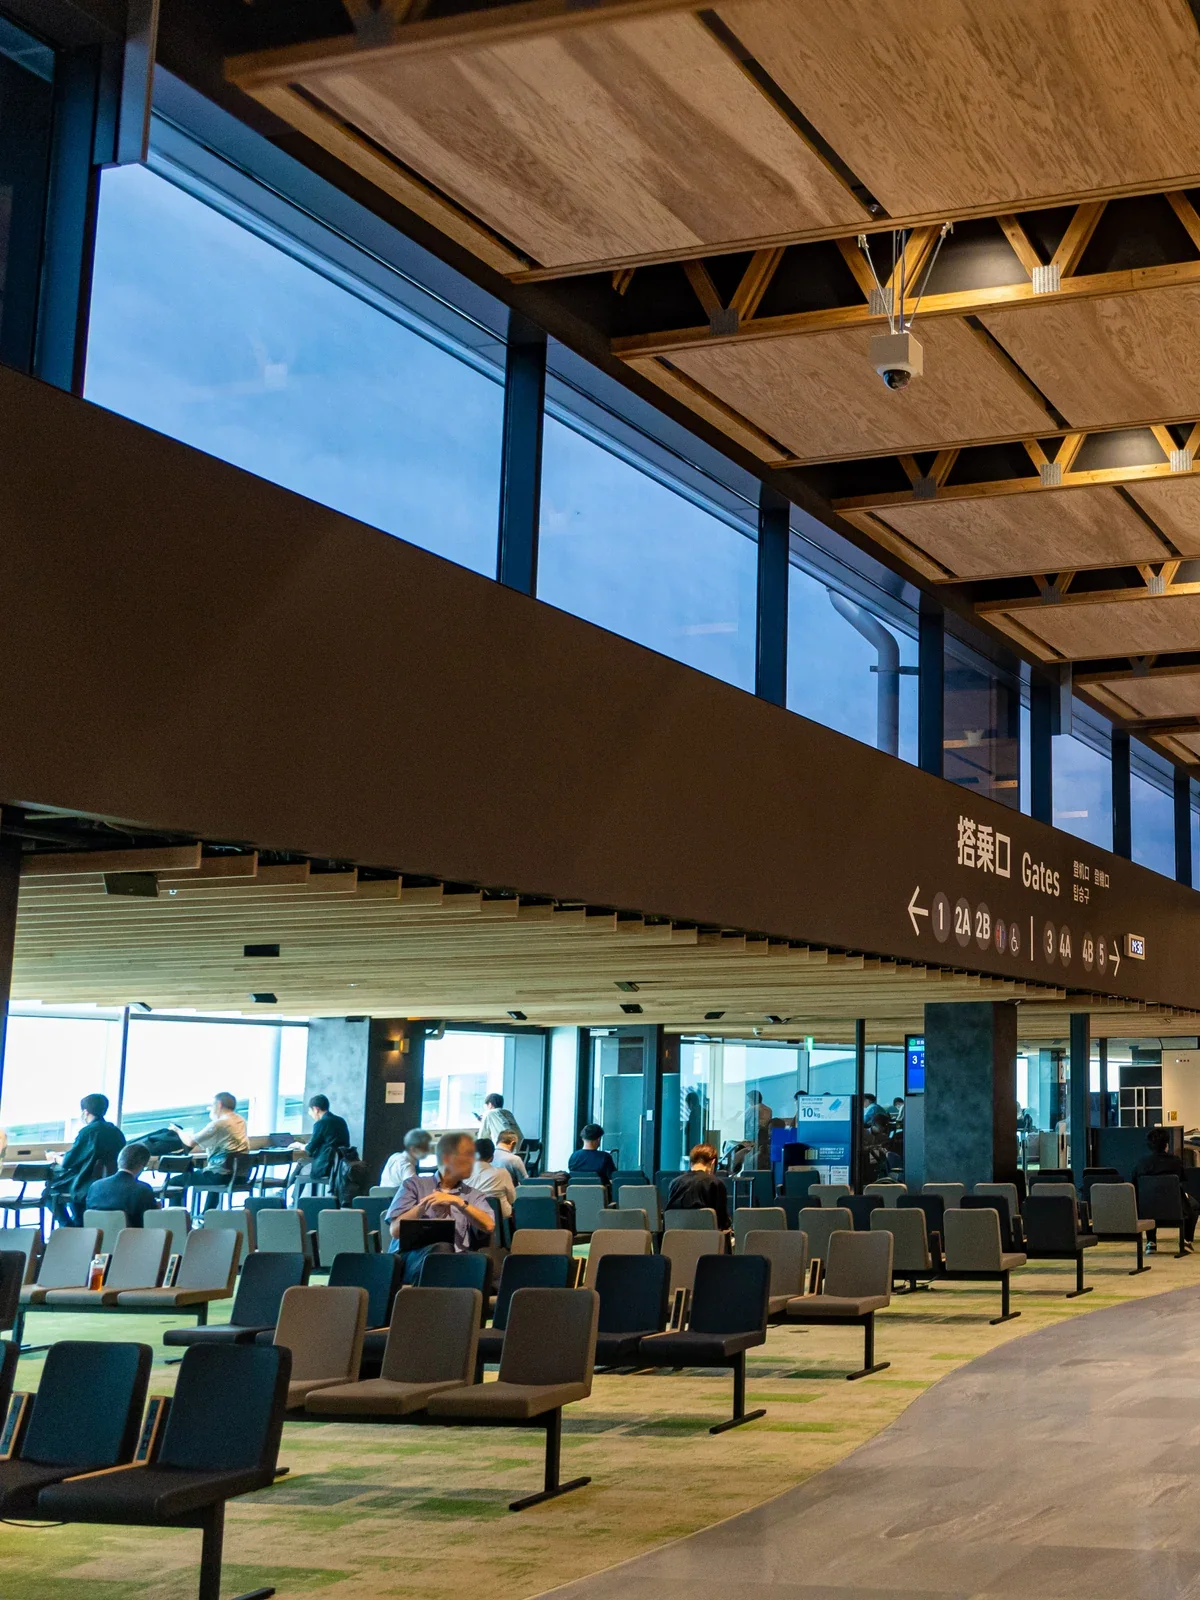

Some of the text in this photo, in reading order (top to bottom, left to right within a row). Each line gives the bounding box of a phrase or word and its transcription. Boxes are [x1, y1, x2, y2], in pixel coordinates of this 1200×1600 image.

[957, 815, 1011, 879] 搭乗口
[1022, 852, 1061, 897] Gates
[938, 901, 1105, 966] 1 2A 2B 3 4A 4B 5
[912, 1055, 918, 1065] 3
[801, 1107, 821, 1119] 10 kg
